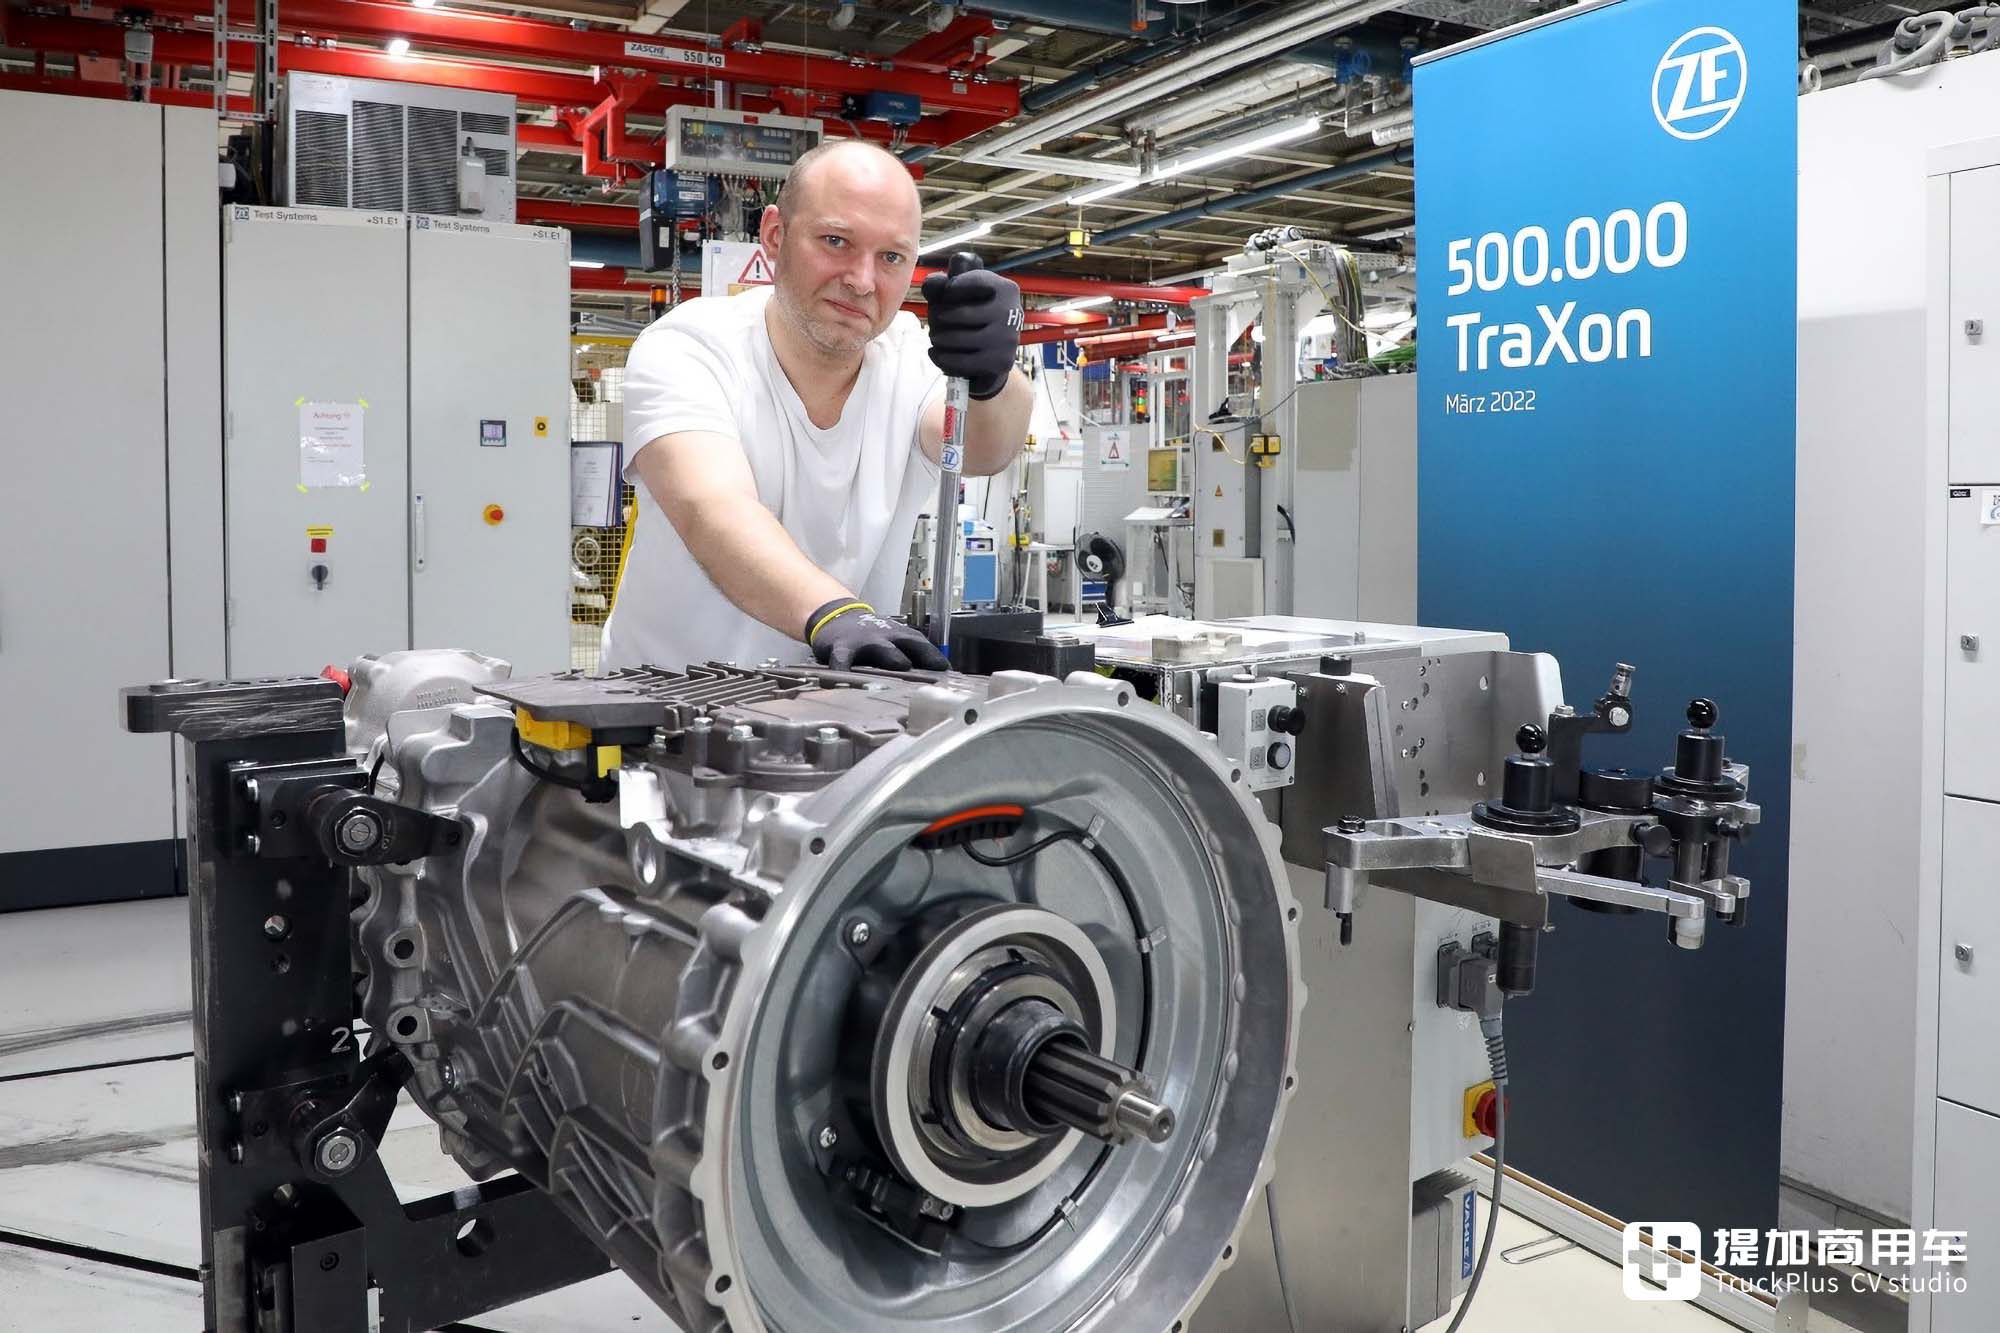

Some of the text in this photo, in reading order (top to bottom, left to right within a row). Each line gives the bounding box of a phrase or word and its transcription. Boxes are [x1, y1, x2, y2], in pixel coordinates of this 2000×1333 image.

[683, 51, 703, 63] 550
[706, 54, 722, 66] kg
[1658, 40, 1742, 126] ZF
[254, 210, 318, 222] Test Systems
[433, 220, 490, 233] Test Systems
[1447, 200, 1689, 297] 500.000
[1446, 301, 1652, 372] TraXon
[1446, 390, 1536, 415] März 2022
[331, 1026, 350, 1053] 2
